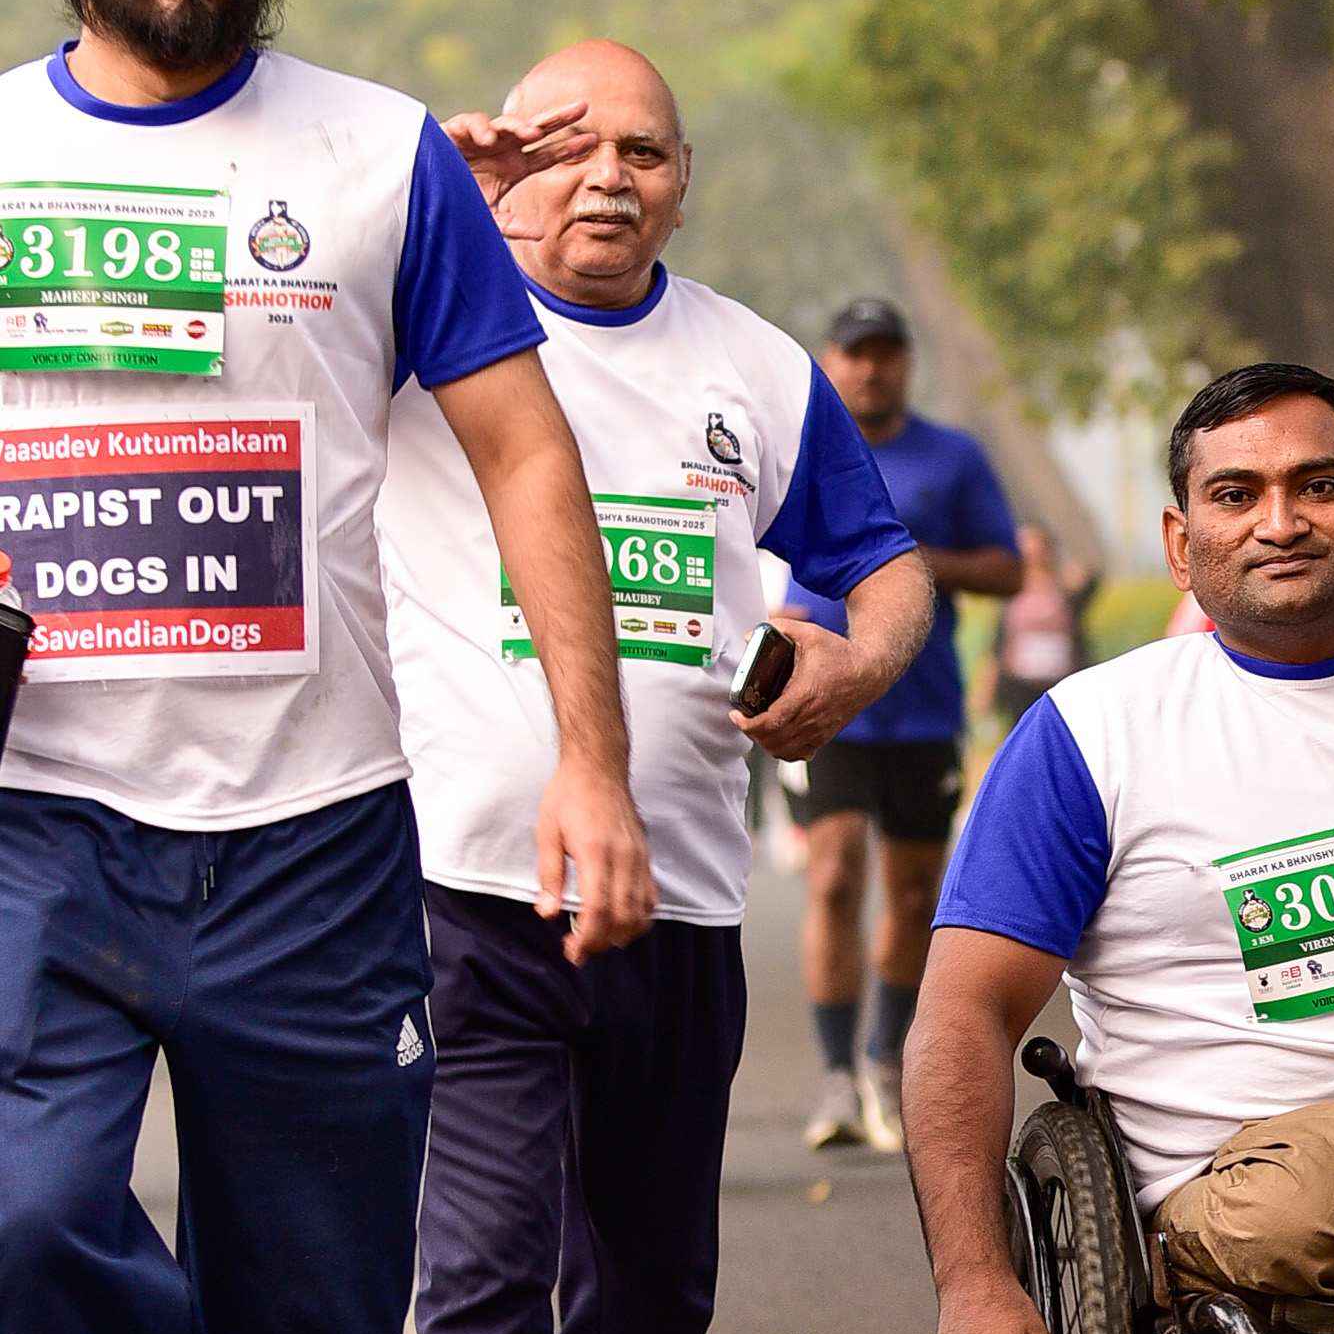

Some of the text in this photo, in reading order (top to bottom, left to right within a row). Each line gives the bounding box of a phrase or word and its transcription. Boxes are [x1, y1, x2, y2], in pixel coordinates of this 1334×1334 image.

[20, 224, 182, 282] 3198
[41, 290, 149, 305] MAHEEP SINGH
[224, 292, 333, 311] SHAHOTHON
[108, 427, 287, 456] Kutumbakam
[0, 485, 284, 532] RAPIST OUT
[626, 515, 680, 528] SHAHOTHON
[683, 520, 705, 530] 2025
[35, 555, 238, 599] DOGS IN
[27, 619, 262, 651] SaveIndianDogs
[1229, 864, 1270, 882] BHARAT
[1272, 860, 1286, 872] KA
[1259, 934, 1275, 944] KM
